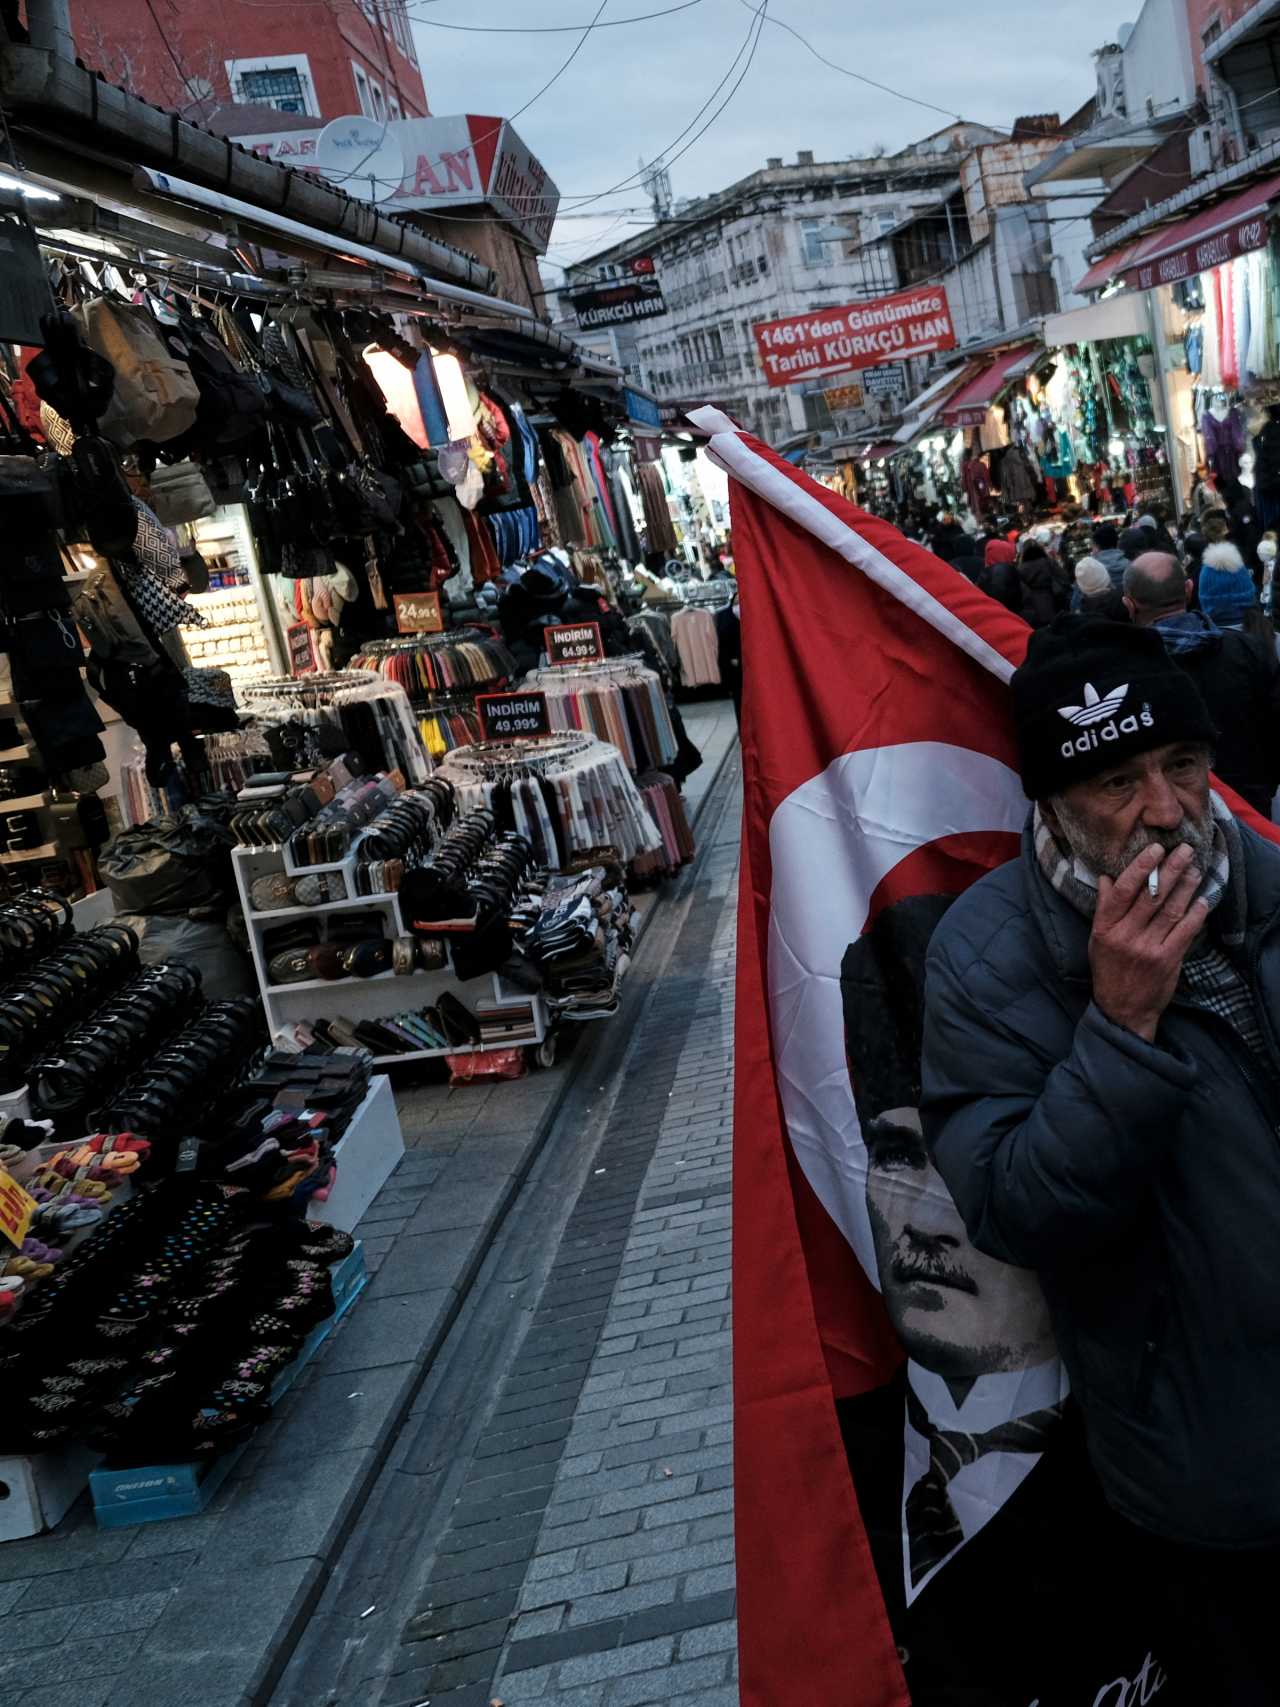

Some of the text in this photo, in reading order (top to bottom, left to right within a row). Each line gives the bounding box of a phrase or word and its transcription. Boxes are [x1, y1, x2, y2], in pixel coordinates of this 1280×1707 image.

[395, 150, 474, 198] AN
[634, 298, 664, 314] HAN
[761, 297, 942, 348] 1461'den Günümüze
[766, 317, 950, 374] Tarihi KÜRKÇÜ HAN
[554, 628, 593, 643] İNDİRİM
[487, 700, 540, 717] İNDİRİM
[1061, 711, 1154, 757] adidas
